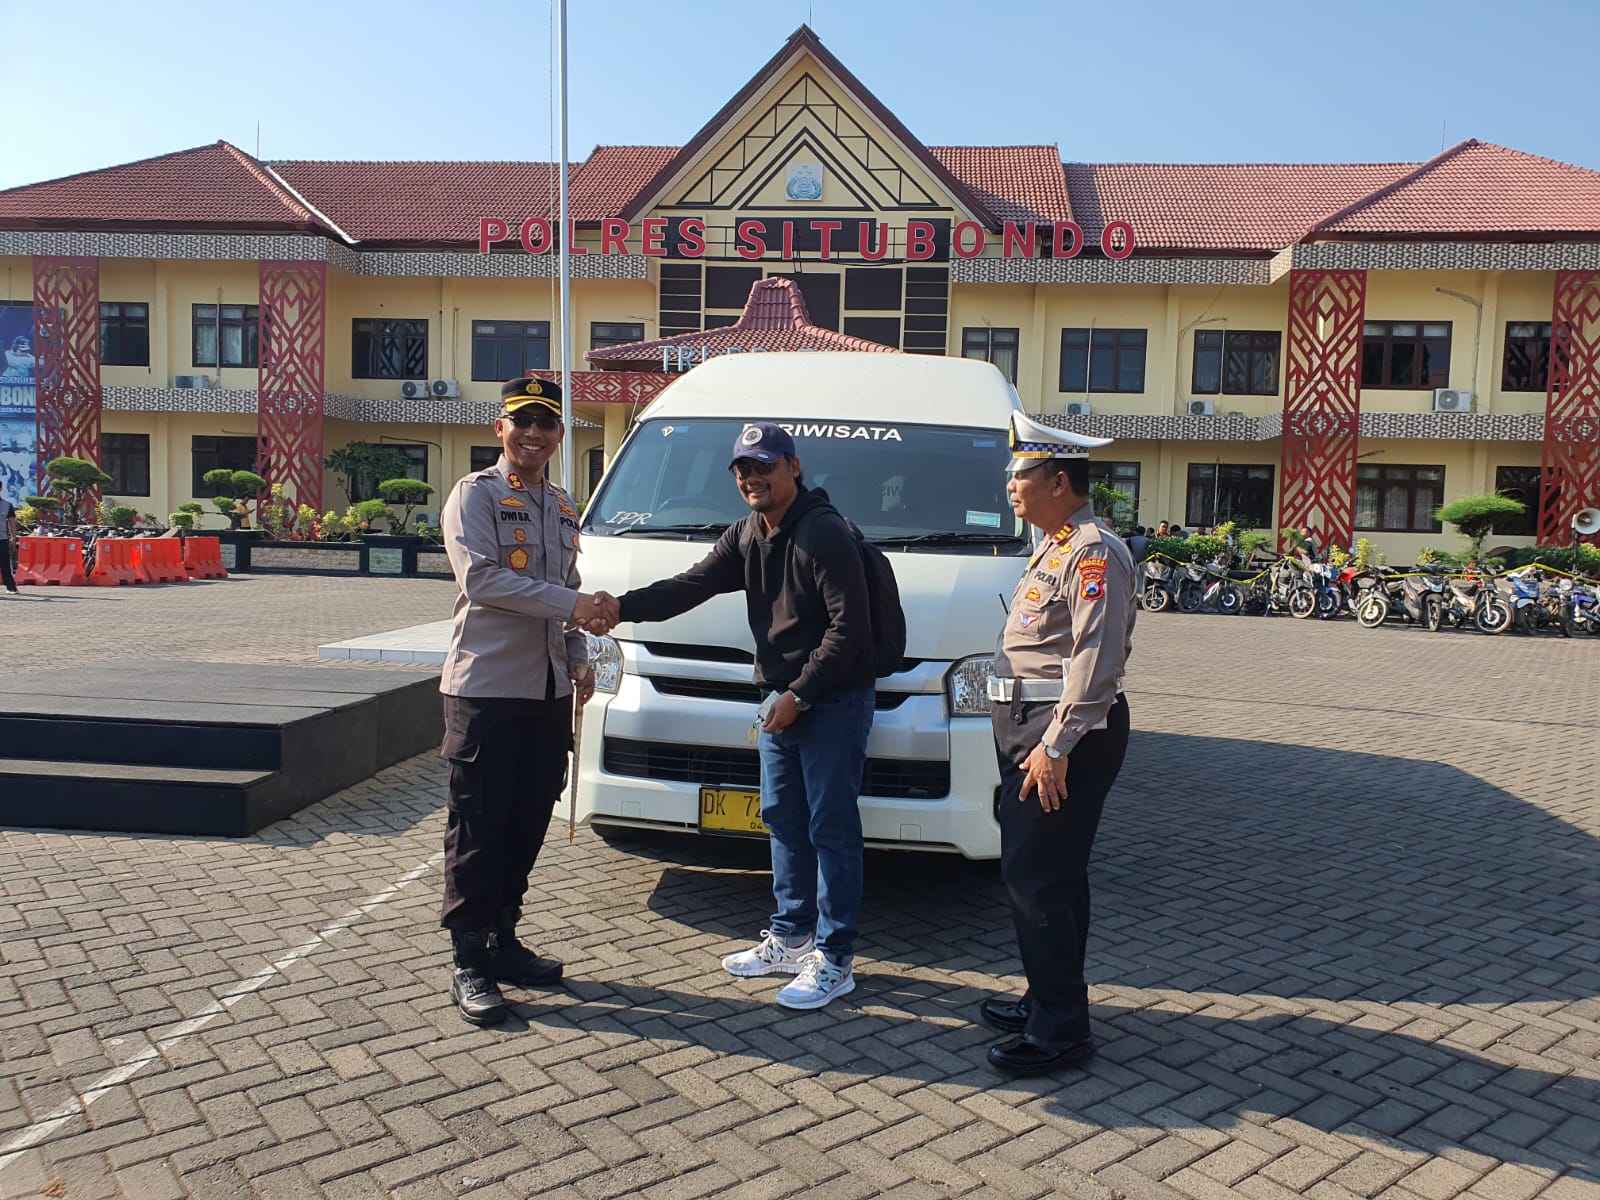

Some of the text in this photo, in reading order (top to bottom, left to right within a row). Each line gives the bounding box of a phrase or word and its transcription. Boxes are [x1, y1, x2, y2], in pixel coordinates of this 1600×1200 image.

[479, 216, 1136, 260] POLRES SITUBONDO
[659, 345, 708, 373] TRI
[0, 386, 37, 406] BON
[742, 423, 903, 442] RIWISATA
[501, 511, 518, 521] DWI
[1034, 570, 1057, 587] POLRI
[704, 792, 726, 816] DK
